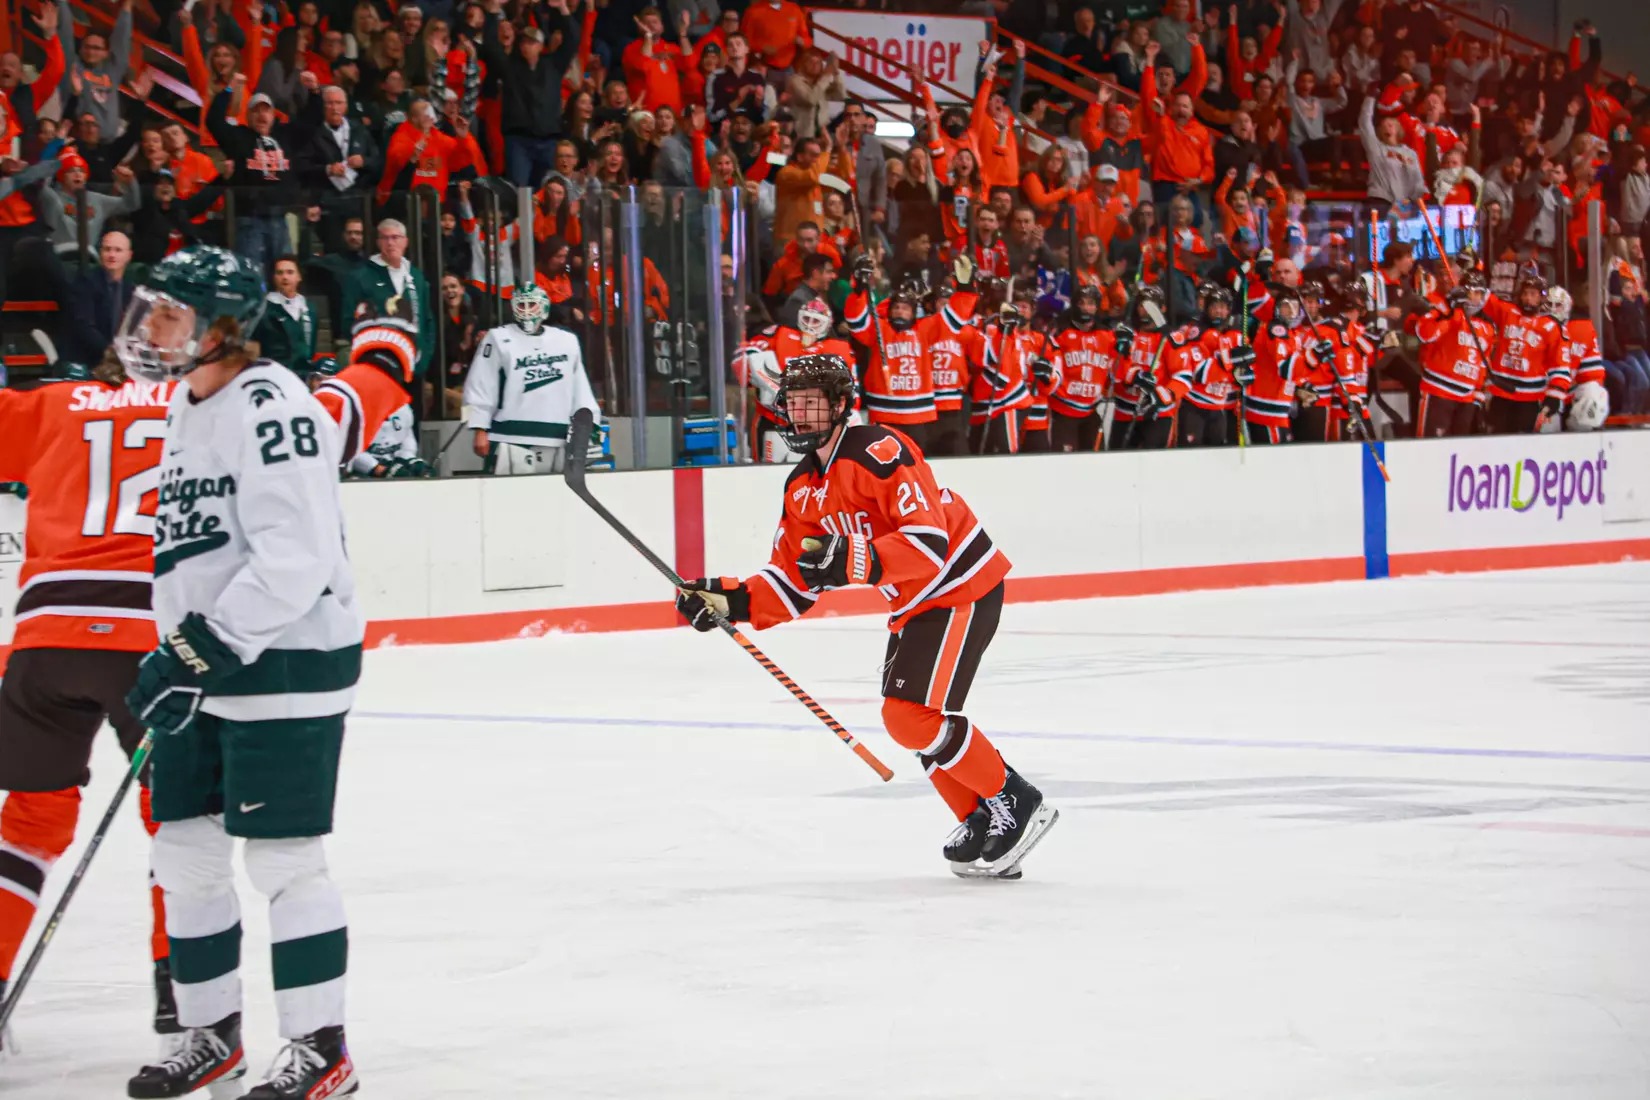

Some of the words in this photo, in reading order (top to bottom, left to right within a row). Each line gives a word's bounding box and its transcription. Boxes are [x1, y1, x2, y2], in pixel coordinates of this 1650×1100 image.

[844, 22, 962, 82] meijer
[483, 343, 492, 359] 0
[514, 352, 569, 371] Michigan
[524, 367, 563, 381] State
[256, 416, 320, 466] 28
[82, 419, 168, 537] 12
[897, 481, 930, 517] 24
[1448, 449, 1608, 521] loanDepot
